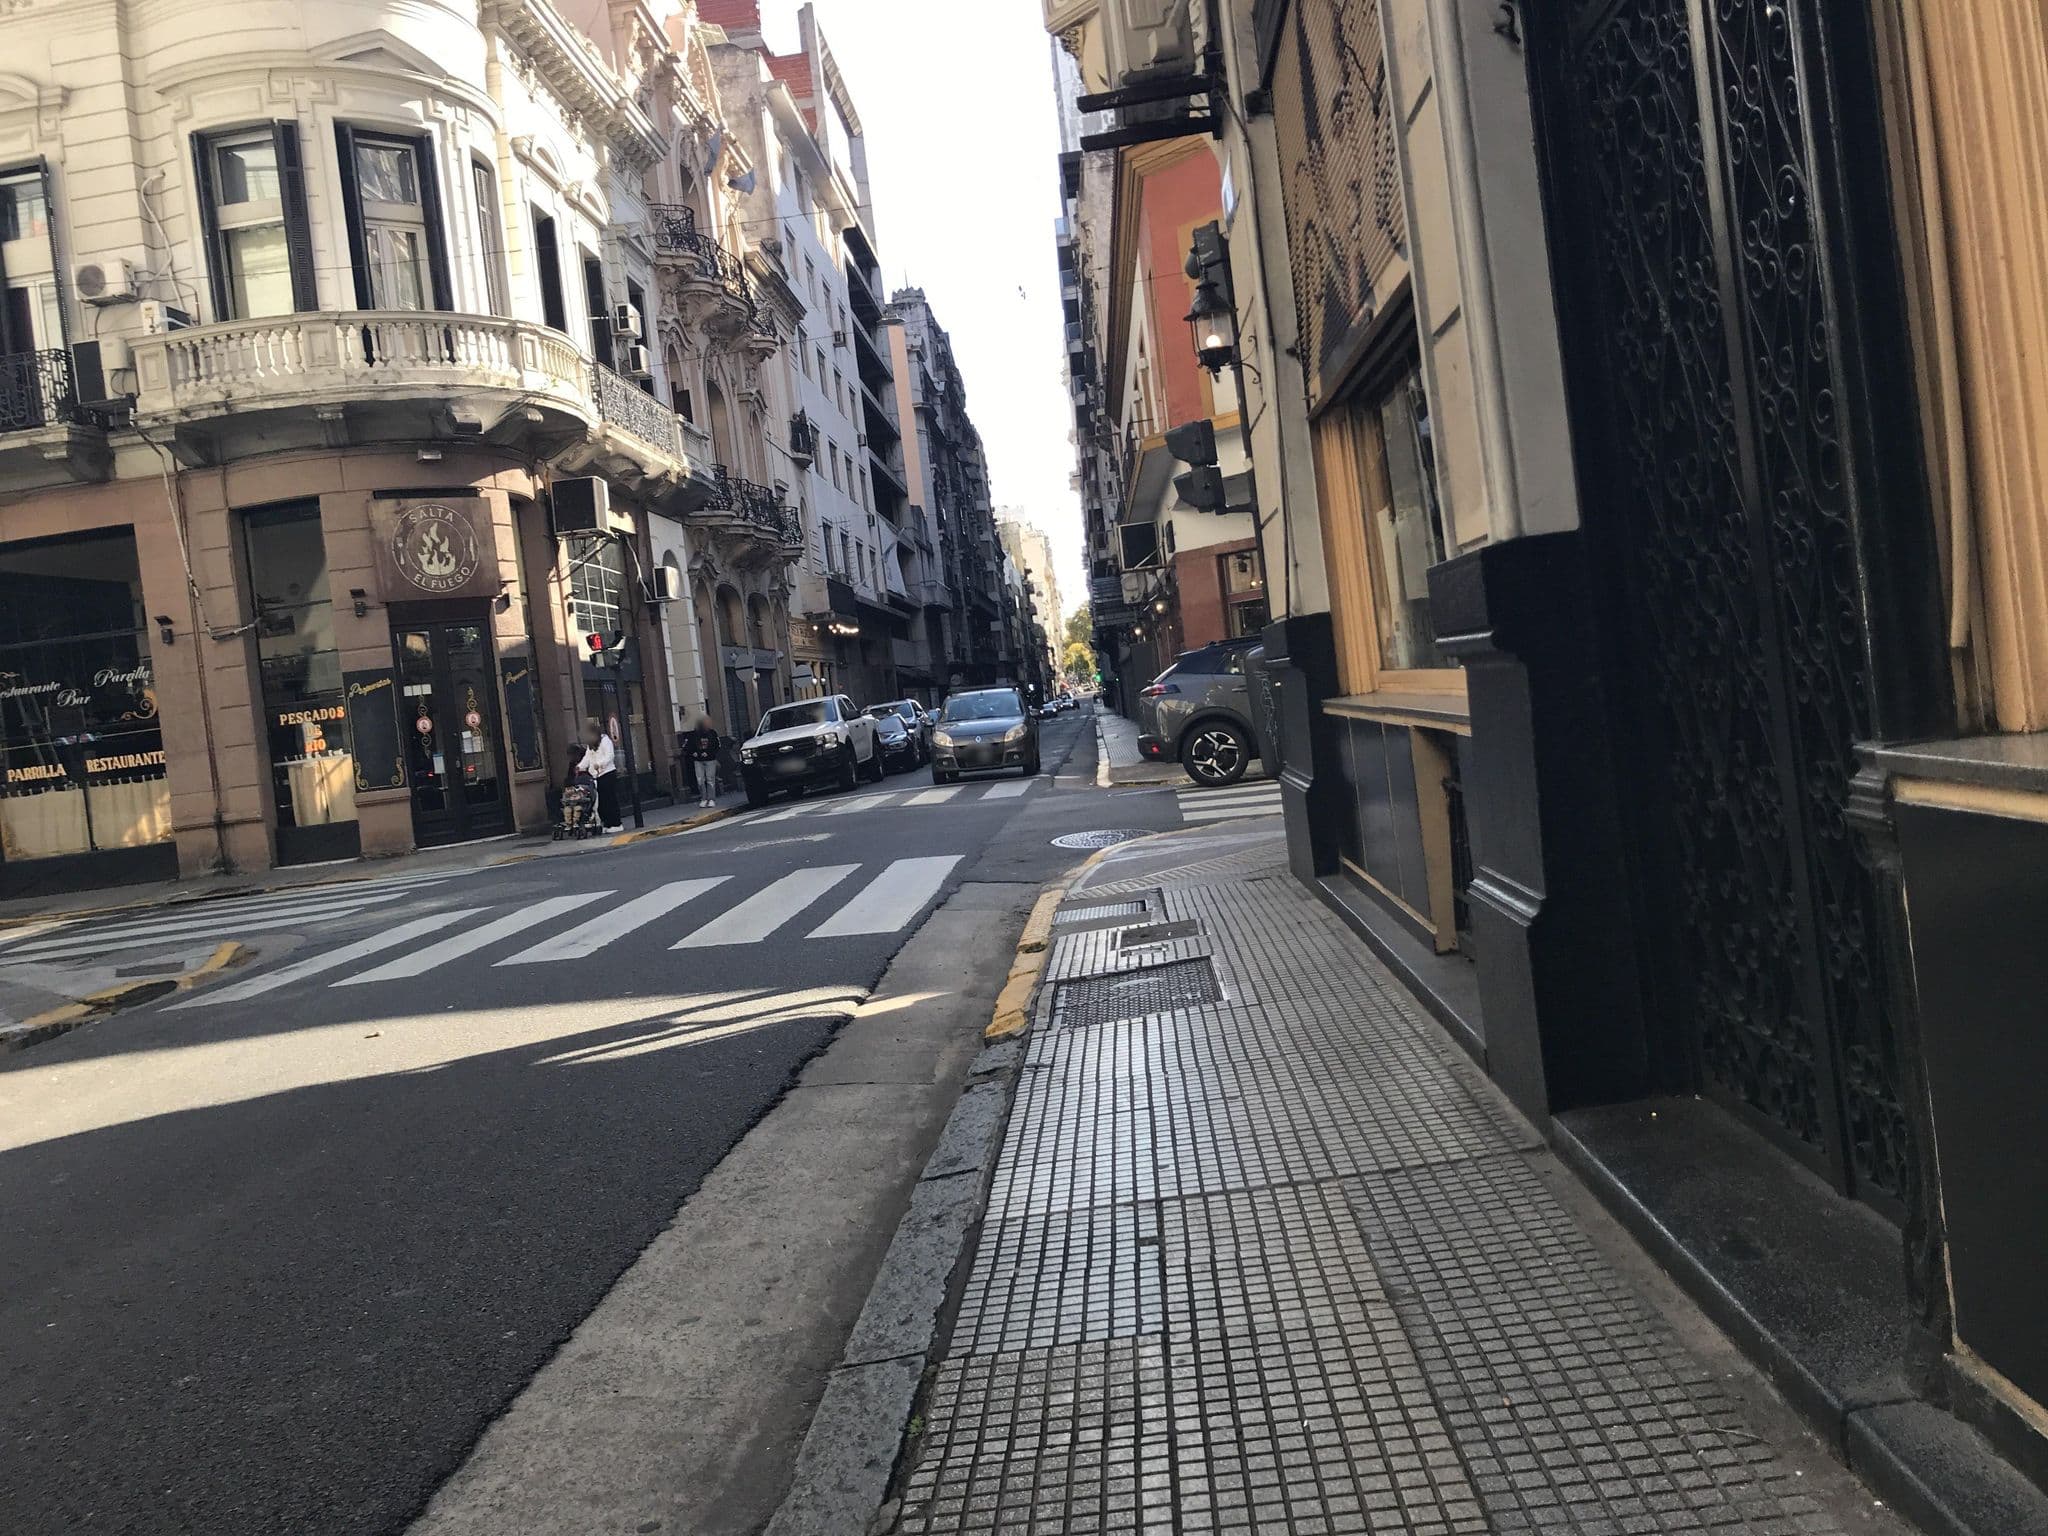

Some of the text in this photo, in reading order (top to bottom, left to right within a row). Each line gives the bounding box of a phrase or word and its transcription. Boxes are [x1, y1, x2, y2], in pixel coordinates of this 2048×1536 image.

[408, 508, 454, 523] SALTA
[414, 566, 471, 589] EL FUEGO
[94, 665, 150, 688] Parrilla
[0, 681, 61, 699] estaurante
[57, 689, 91, 707] Bar
[279, 705, 346, 726] PESCADOS
[7, 750, 167, 783] PARRILLA RESTAURANTE
